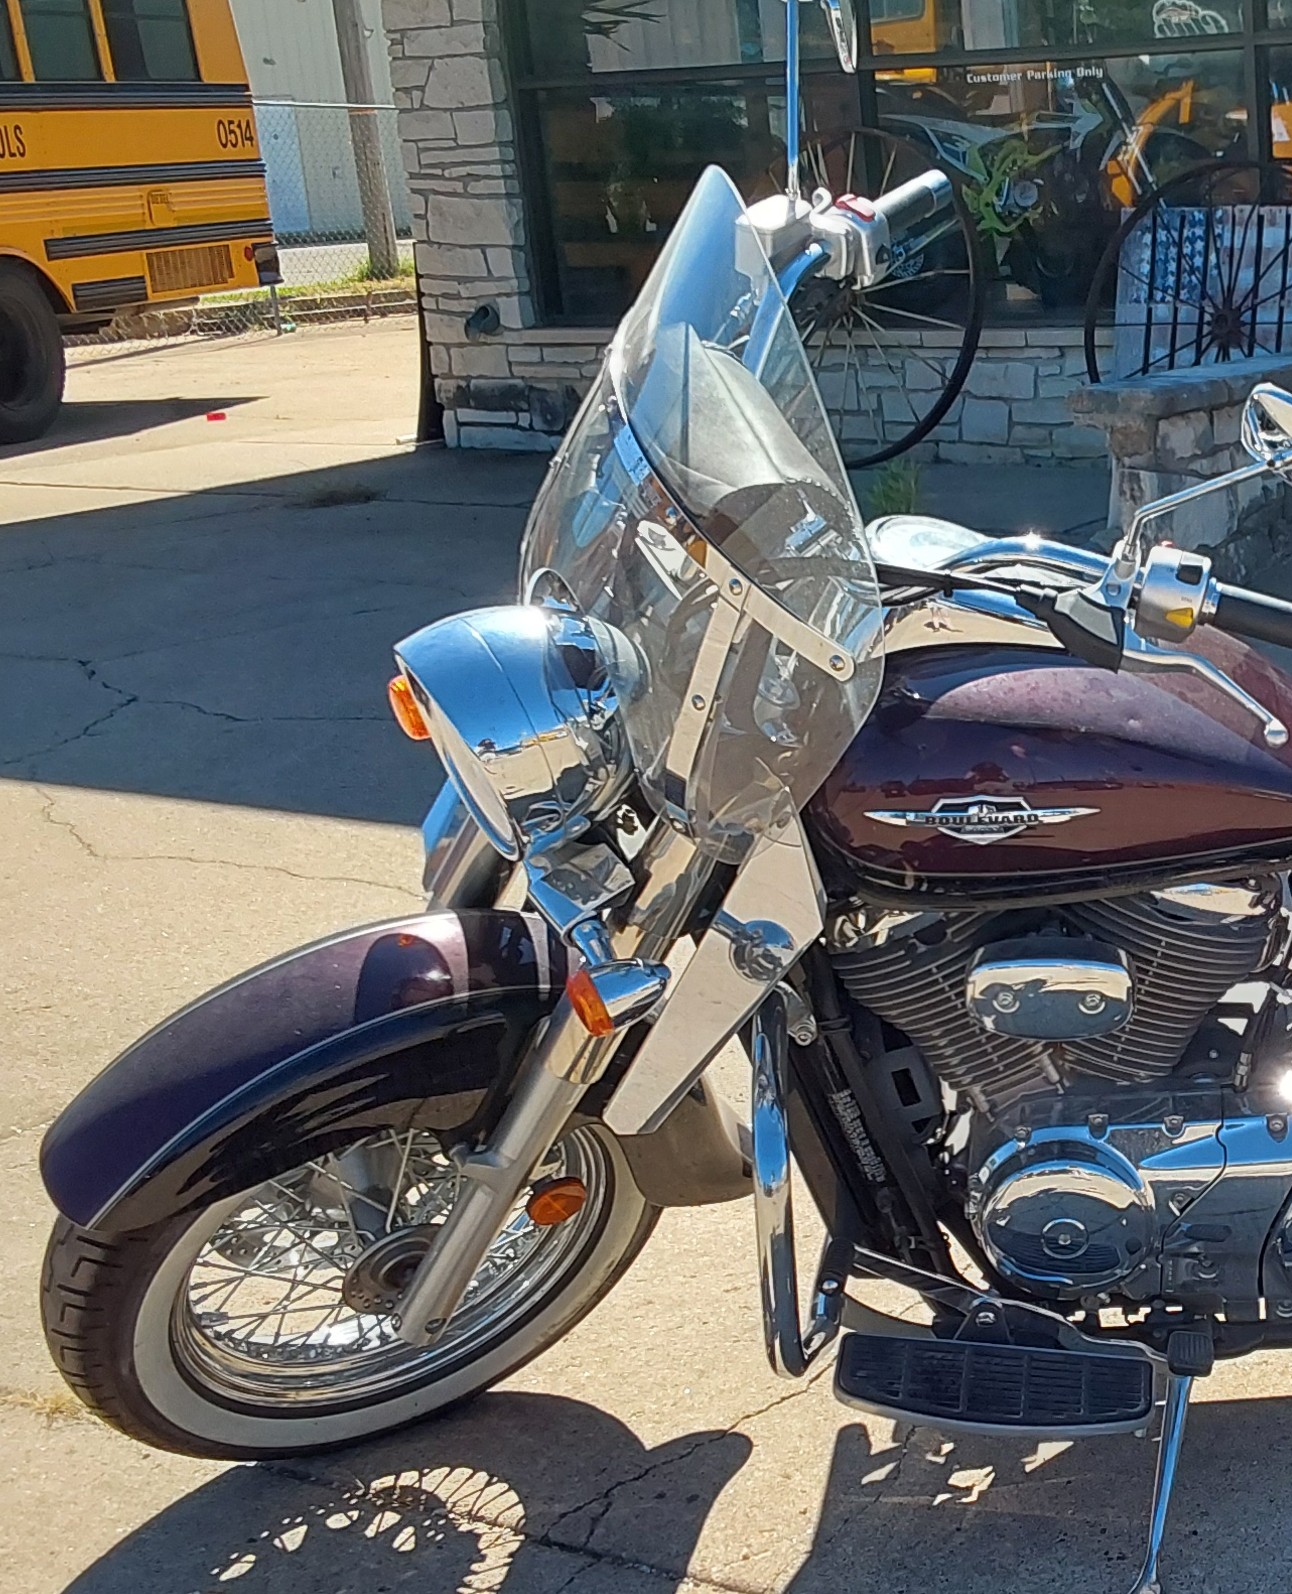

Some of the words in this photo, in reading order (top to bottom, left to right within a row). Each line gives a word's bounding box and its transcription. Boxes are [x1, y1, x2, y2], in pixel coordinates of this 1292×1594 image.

[966, 72, 1022, 84] Customer
[1027, 69, 1072, 81] Parking
[1076, 66, 1104, 78] Only
[217, 119, 254, 149] 0514
[924, 813, 1040, 826] BOULEVARD
